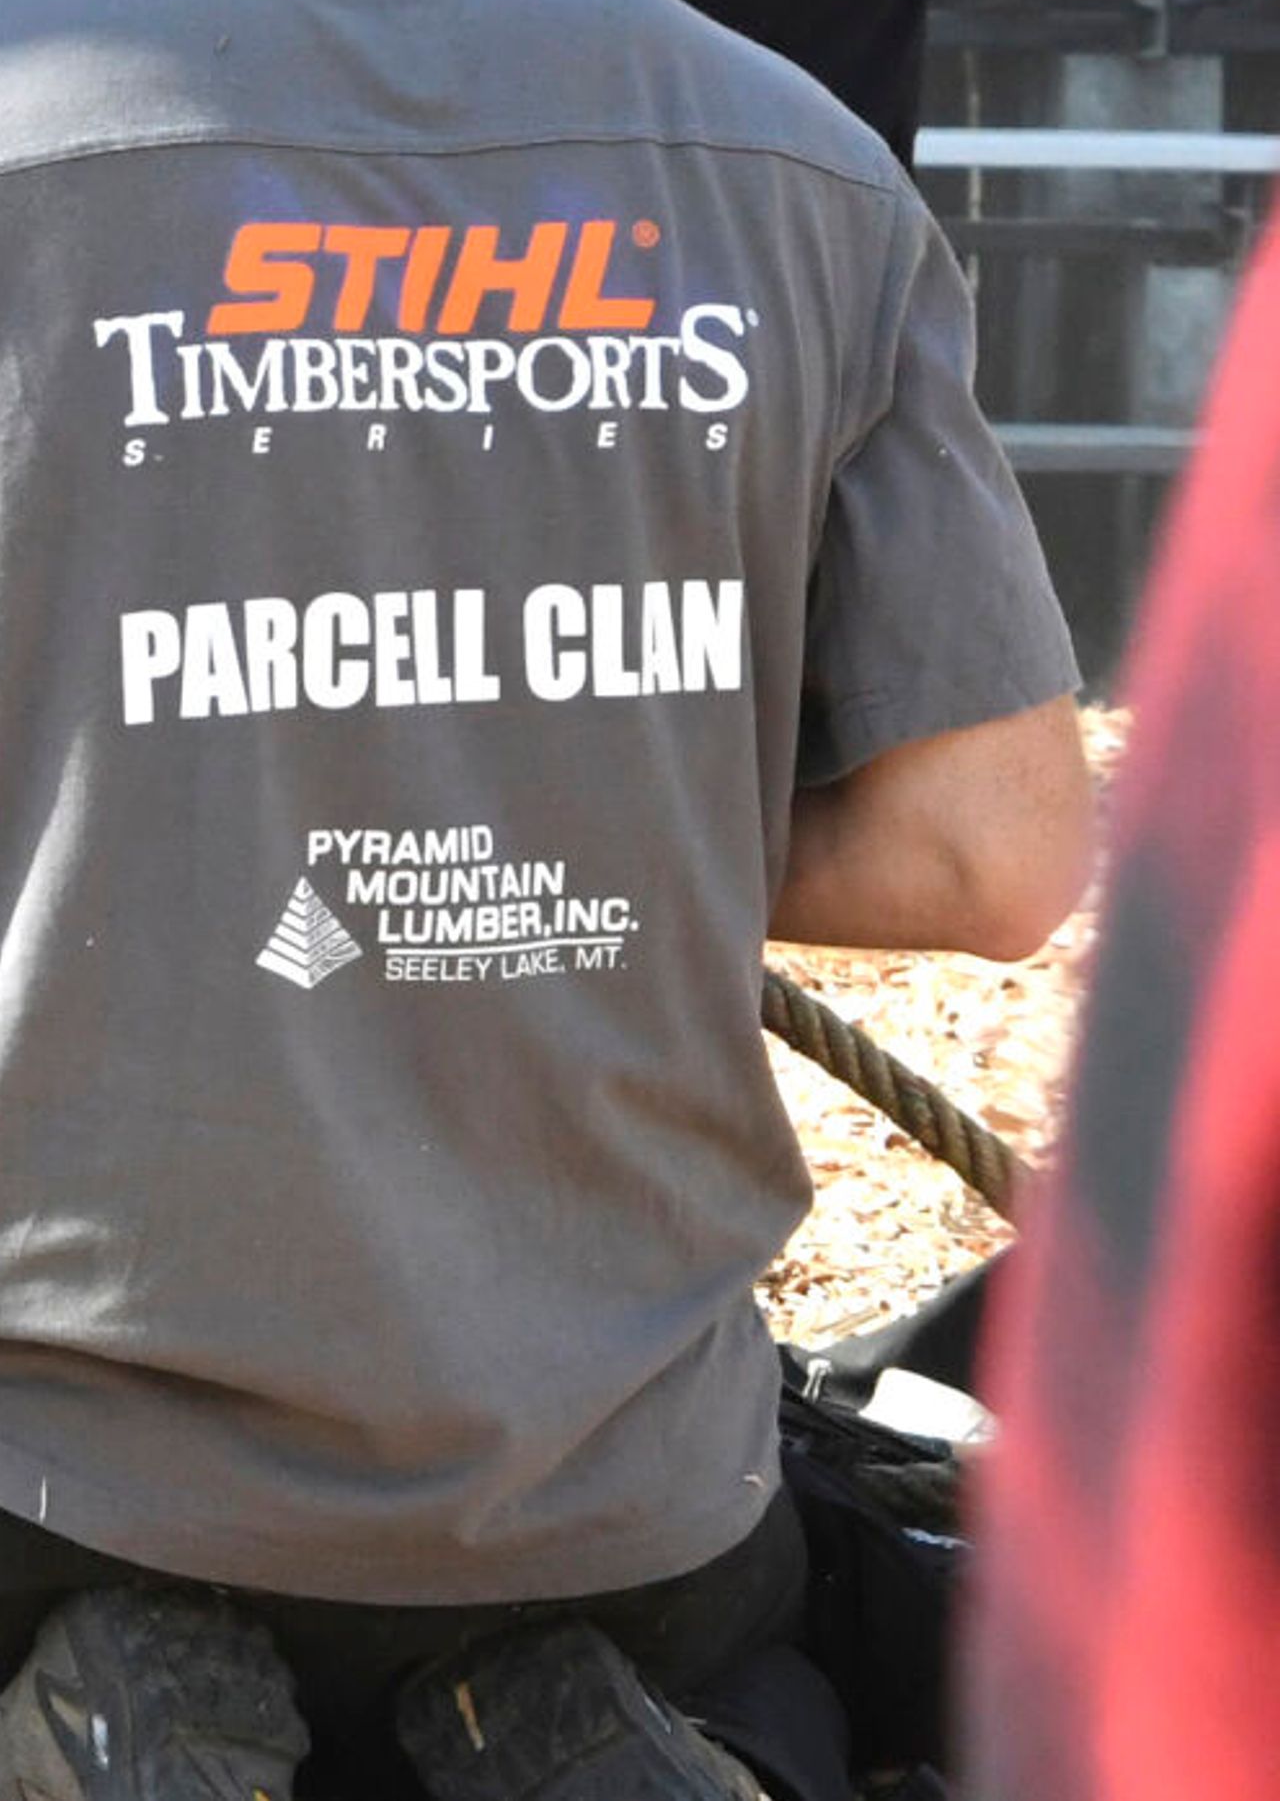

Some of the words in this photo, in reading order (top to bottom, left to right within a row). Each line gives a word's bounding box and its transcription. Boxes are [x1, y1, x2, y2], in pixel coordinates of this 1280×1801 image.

[208, 221, 655, 335] STIHL
[94, 304, 748, 426] TIMBERSPORTS
[121, 590, 500, 724] PARCELL
[524, 580, 743, 701] CLAN
[308, 825, 493, 866] PYRAMID
[347, 861, 565, 904] MOUNTAIN
[385, 956, 492, 982] SEELEY
[575, 947, 627, 971] MT.
